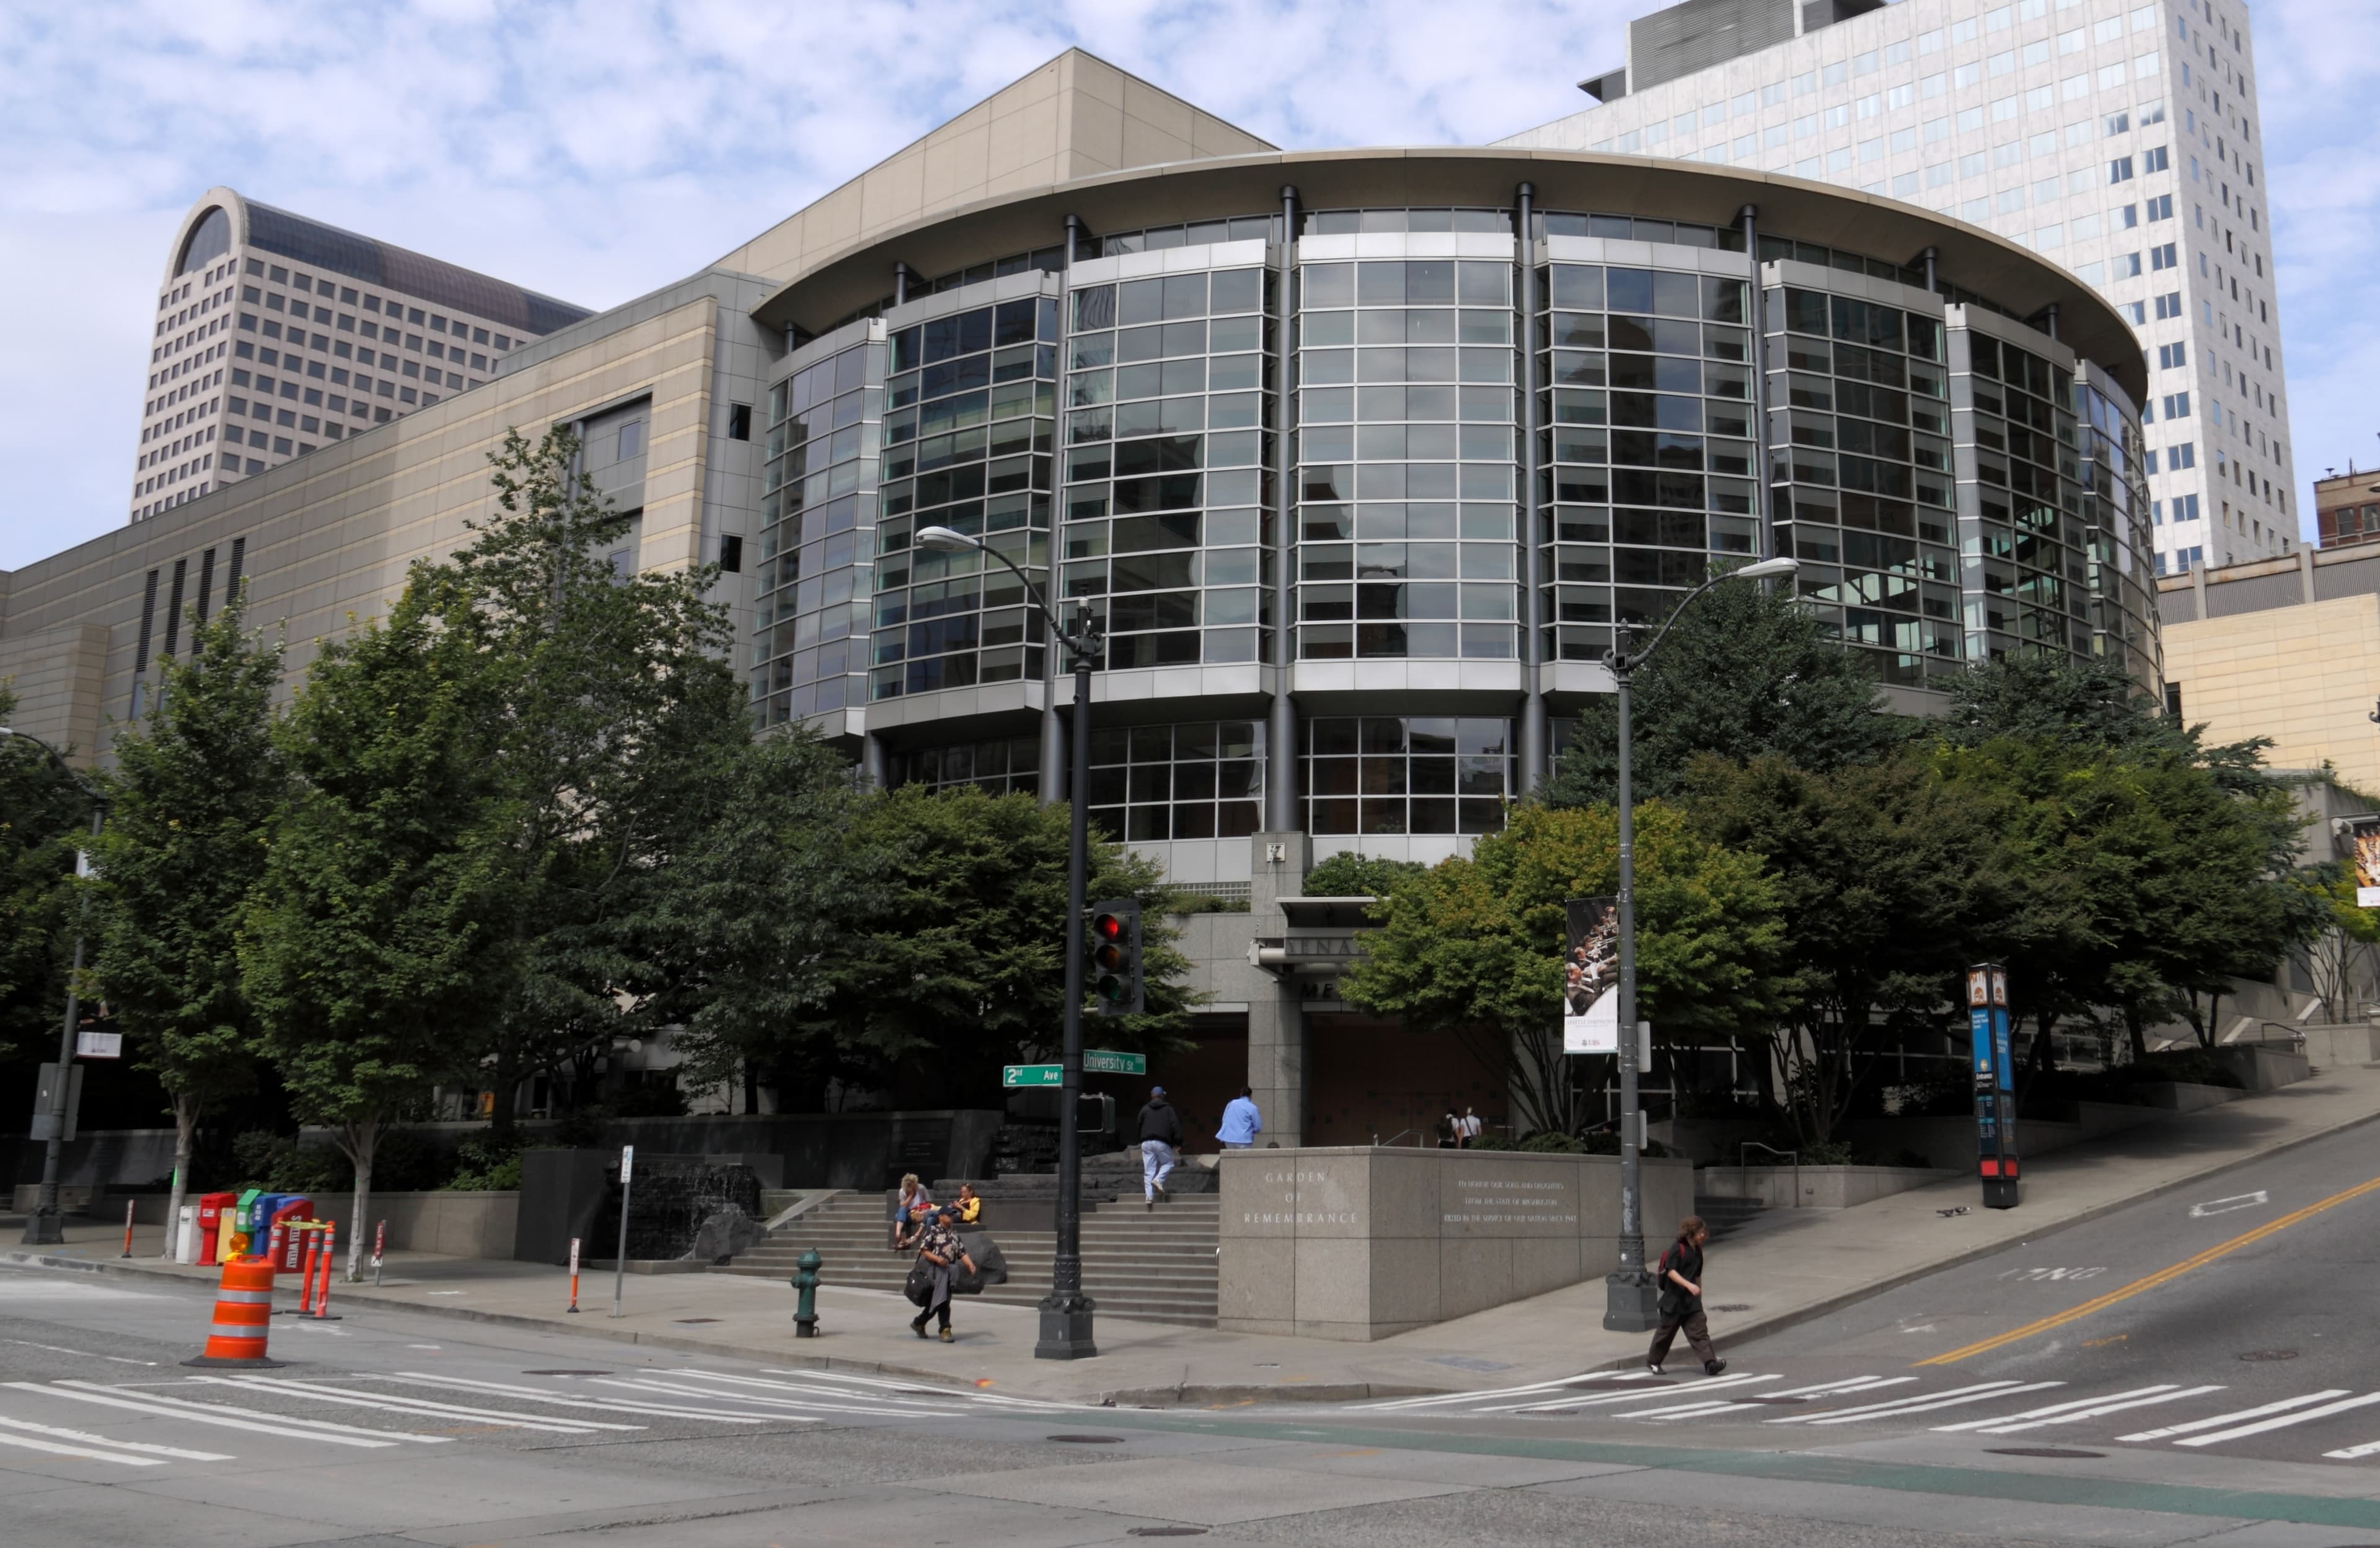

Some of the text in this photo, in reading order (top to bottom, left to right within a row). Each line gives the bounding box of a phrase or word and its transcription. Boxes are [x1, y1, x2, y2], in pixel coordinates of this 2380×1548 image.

[1083, 1052, 1125, 1071] University
[1127, 1060, 1134, 1071] St
[1007, 1068, 1059, 1083] 2nd Ave
[1265, 1172, 1325, 1182] GARDEN
[1458, 1180, 1466, 1188] TO
[1285, 1193, 1302, 1203] OF
[1465, 1197, 1482, 1205] FROM
[1244, 1213, 1359, 1224] REMEMBRANCE
[286, 1215, 302, 1269] STTLE WEEKLY
